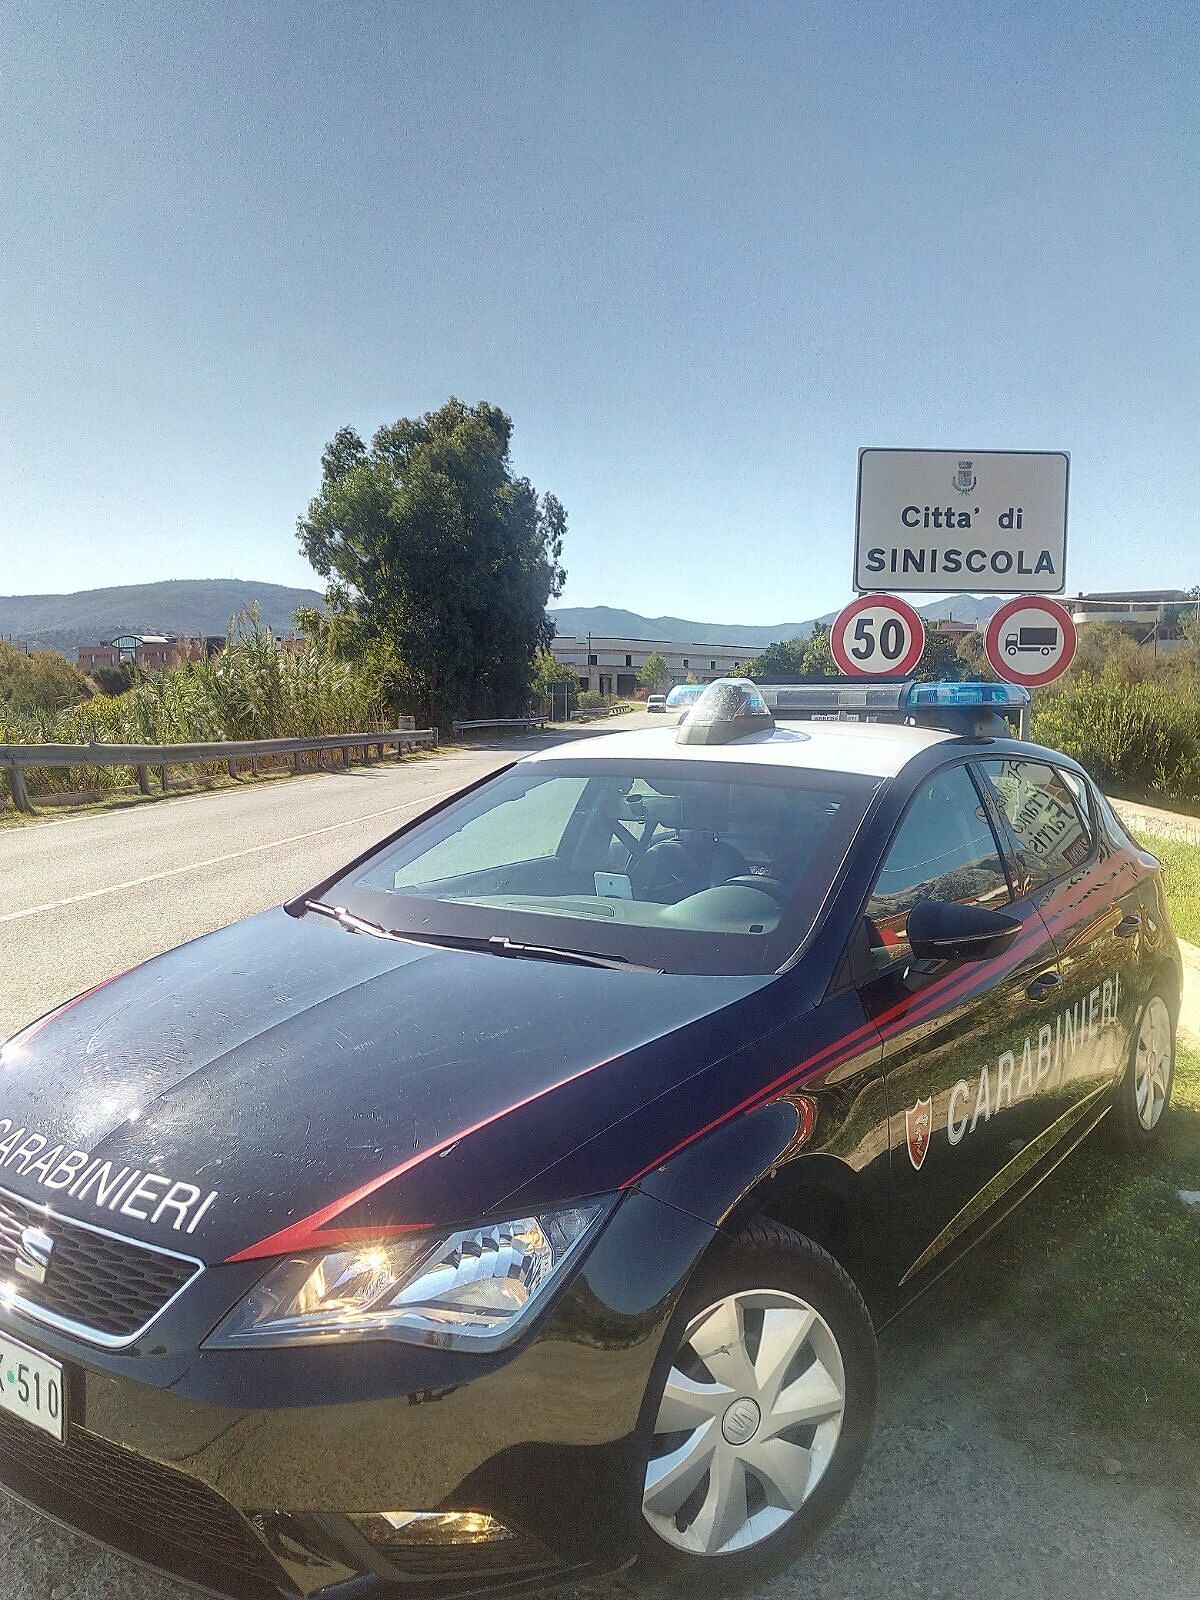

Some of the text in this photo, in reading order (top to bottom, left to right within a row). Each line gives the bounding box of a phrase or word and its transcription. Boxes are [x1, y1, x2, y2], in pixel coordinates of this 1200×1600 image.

[901, 505, 1023, 529] Citta' di
[865, 548, 1056, 575] SINISCOLA
[851, 618, 905, 661] 50
[947, 971, 1120, 1146] CARABINIERI
[17, 1363, 59, 1419] 510
